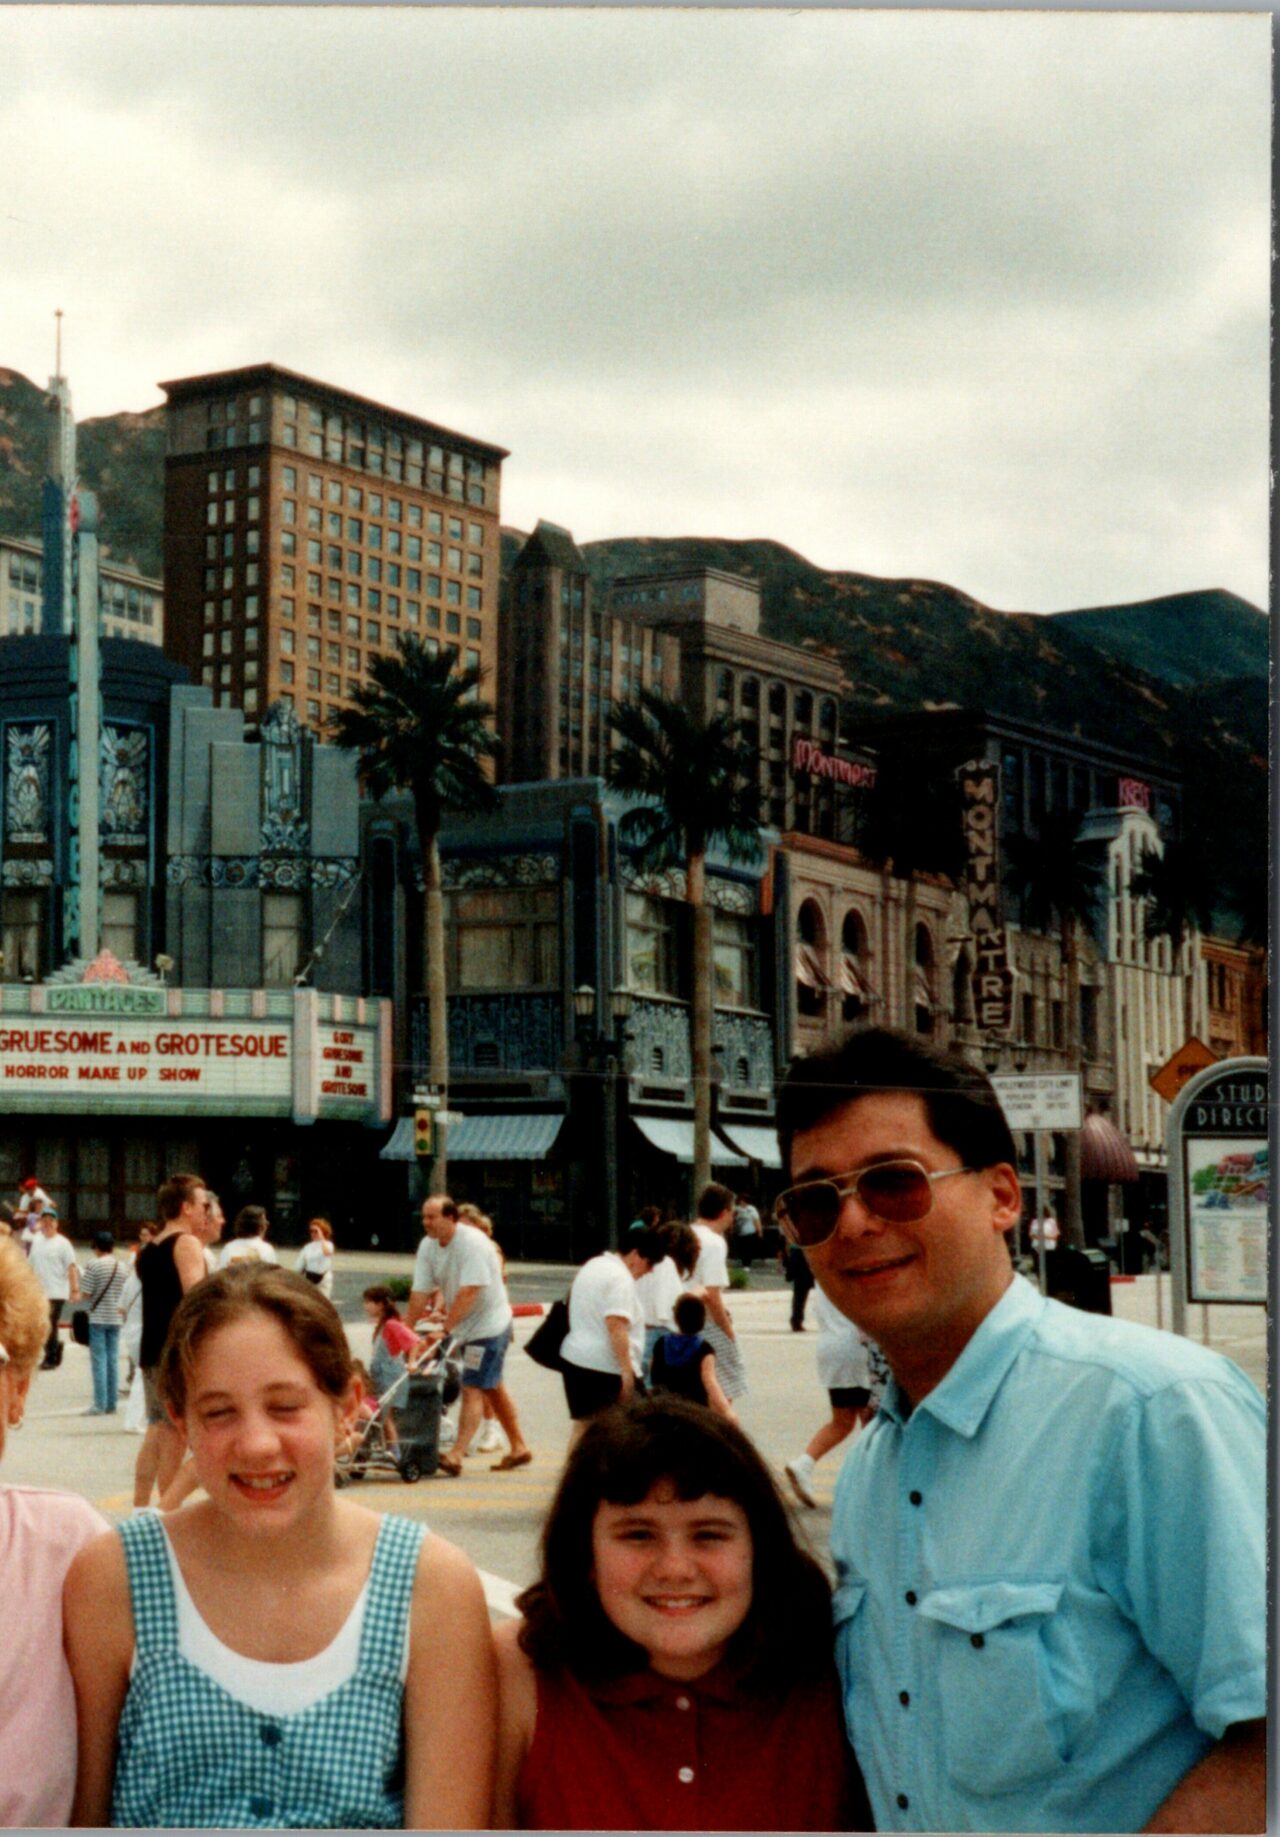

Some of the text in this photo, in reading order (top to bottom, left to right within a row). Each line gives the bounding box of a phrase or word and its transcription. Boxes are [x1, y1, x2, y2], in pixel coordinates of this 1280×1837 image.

[962, 777, 1005, 1026] MONTMARTRE
[52, 990, 161, 1012] PANTAGES
[116, 1041, 151, 1055] AND
[155, 1033, 288, 1057] GROTESQUE
[333, 1031, 354, 1045] GORY
[322, 1047, 365, 1062] GRUESOME
[4, 1065, 201, 1081] HORROR MAKE UP SHOW
[335, 1065, 353, 1078] AND
[321, 1080, 368, 1097] GROTESQUE
